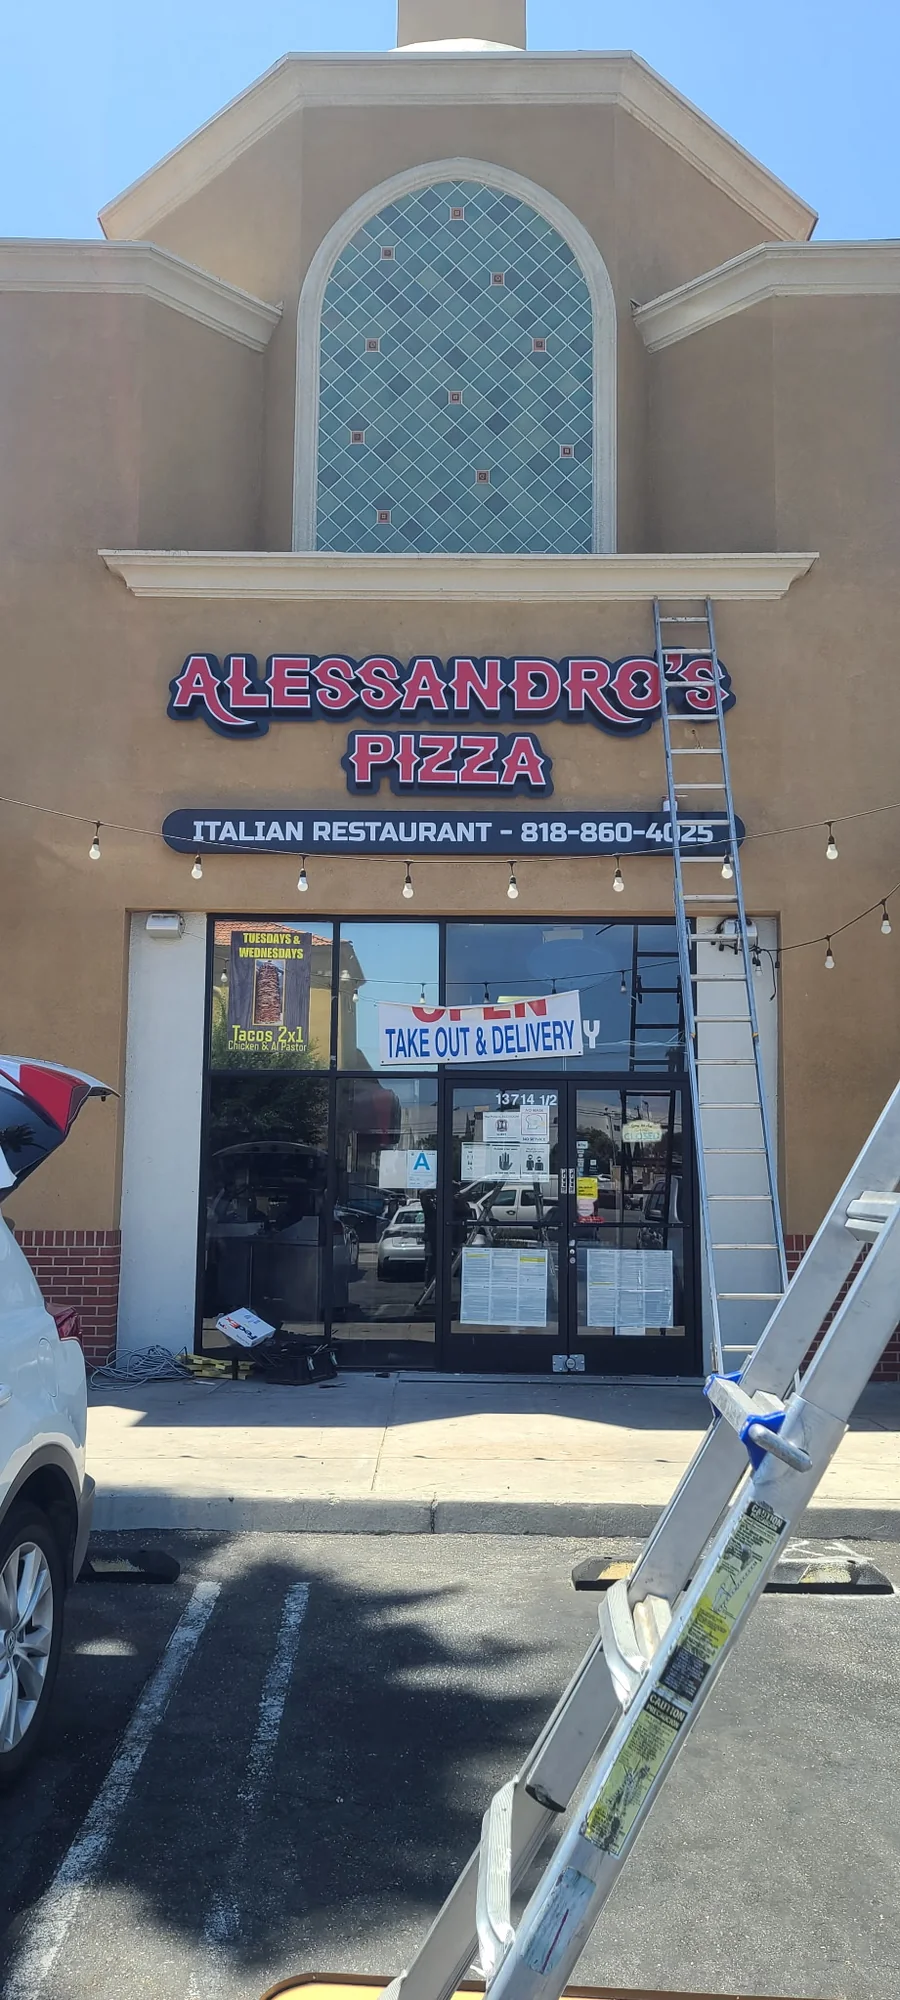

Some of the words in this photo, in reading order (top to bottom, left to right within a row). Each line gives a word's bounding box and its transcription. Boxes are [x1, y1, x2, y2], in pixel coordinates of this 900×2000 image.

[173, 652, 730, 725] ALESSANDRO'S
[349, 734, 546, 785] PIZZA
[193, 821, 303, 841] ITALIAN
[313, 822, 492, 842] RESTAURANT
[521, 822, 714, 843] 818-860-4025
[243, 932, 291, 945] TUESDAYS
[293, 935, 301, 945] &
[239, 947, 304, 959] WEDNESDAYS
[232, 1025, 273, 1042] Tacos
[278, 1026, 304, 1043] 2x1
[385, 1028, 430, 1057] TAKE
[435, 1026, 470, 1057] OUT
[475, 1026, 487, 1056] &
[492, 1020, 575, 1054] DELIVERY
[228, 1041, 259, 1051] Chicken
[261, 1042, 268, 1051] &
[281, 1041, 307, 1052] Pastor
[496, 1093, 535, 1106] 13714
[540, 1095, 557, 1106] 1/2
[413, 1152, 431, 1171] A
[225, 1316, 258, 1341] FedEx
[751, 1504, 783, 1527] CAUTION
[650, 1694, 686, 1722] CAUTION
